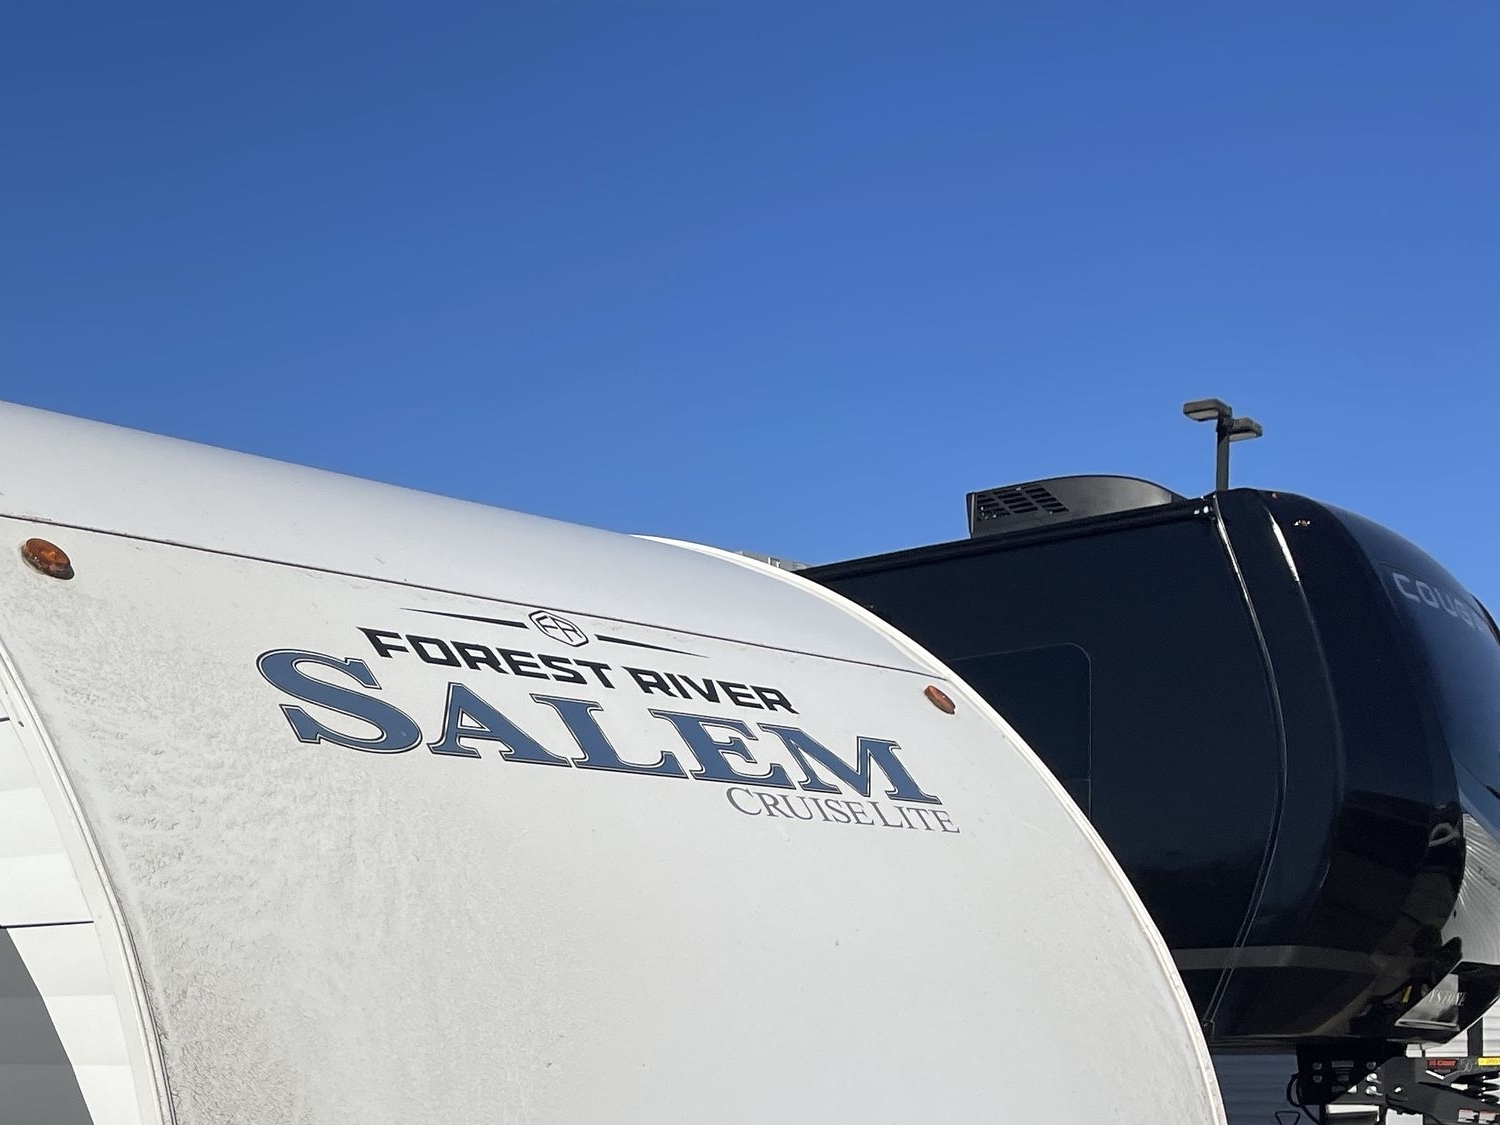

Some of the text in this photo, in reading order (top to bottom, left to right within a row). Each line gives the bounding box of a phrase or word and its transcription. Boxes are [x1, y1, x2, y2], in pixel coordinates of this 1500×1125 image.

[1392, 572, 1484, 631] COUG
[356, 626, 799, 714] FOREST RIVER
[256, 648, 943, 804] SALEM
